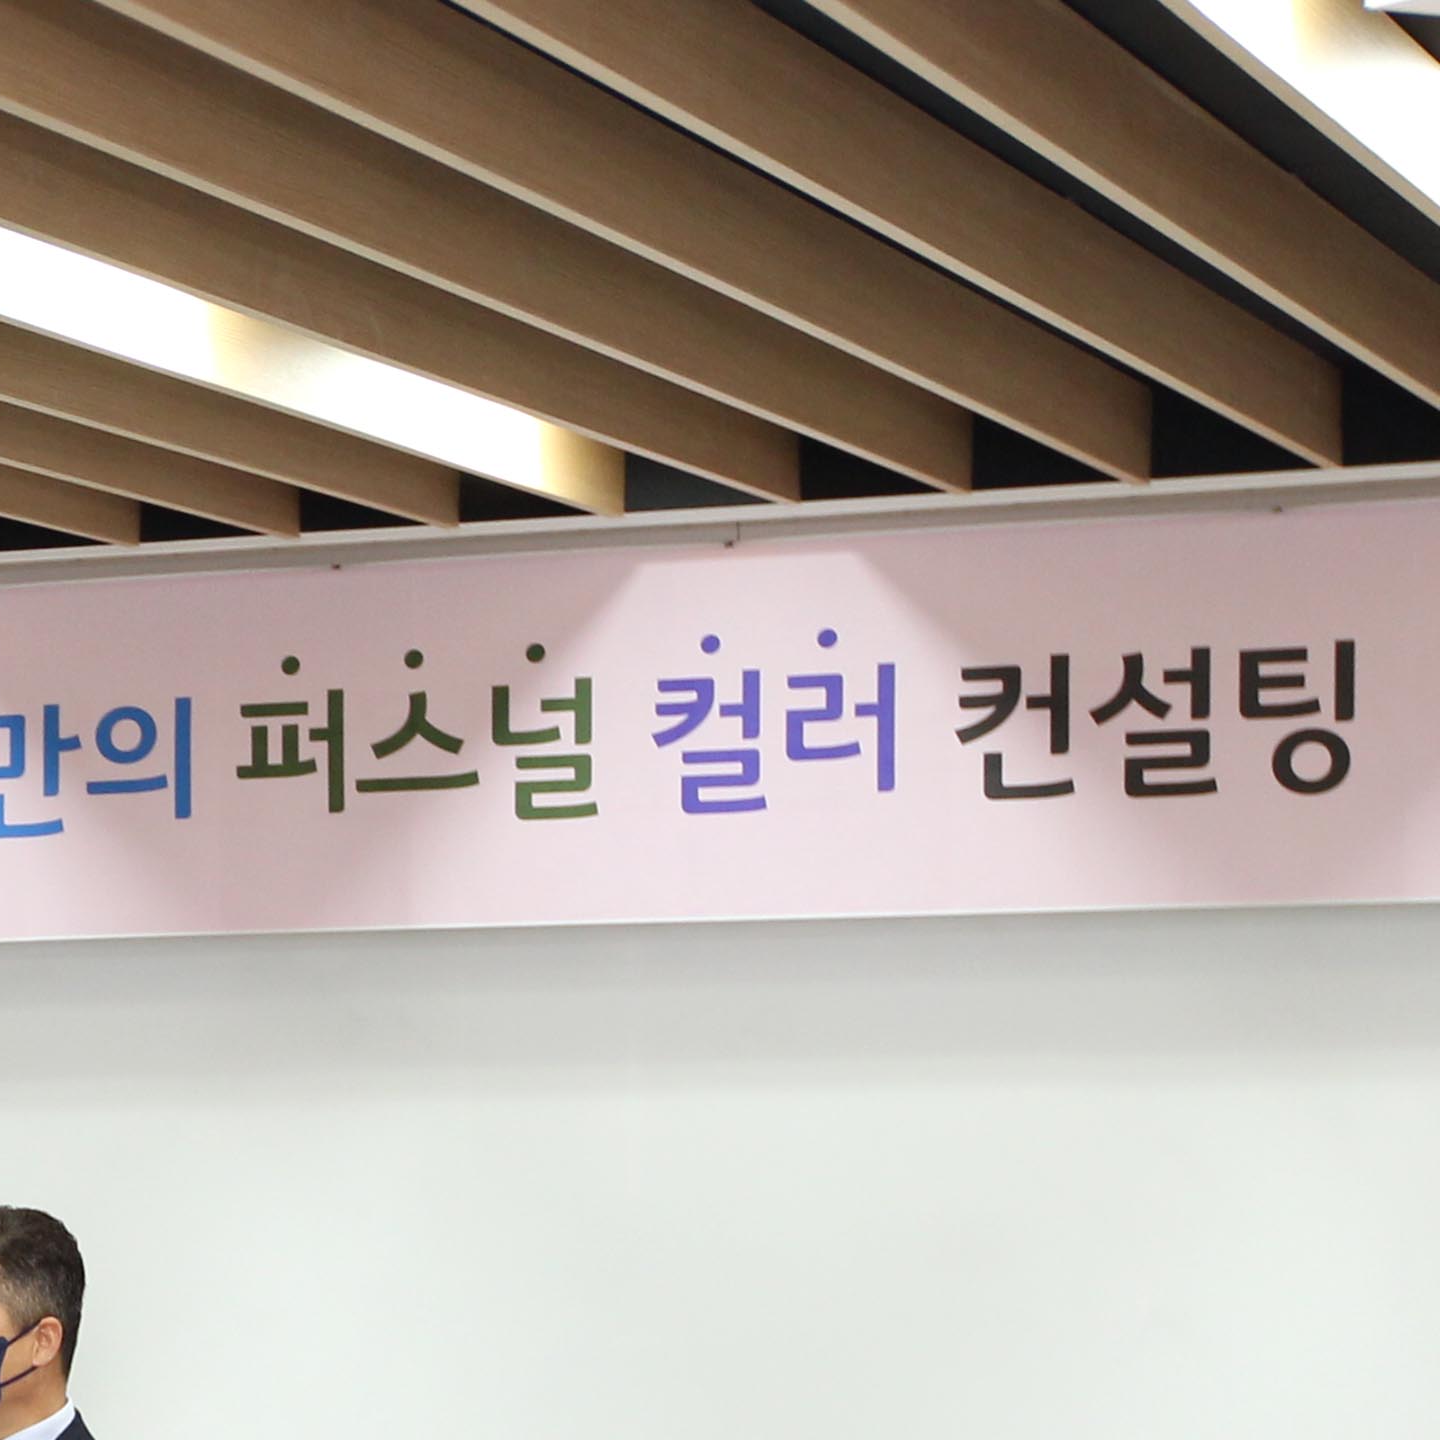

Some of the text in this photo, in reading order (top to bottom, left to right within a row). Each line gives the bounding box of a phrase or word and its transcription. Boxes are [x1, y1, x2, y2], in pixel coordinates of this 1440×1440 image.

[235, 676, 599, 820] 퍼스널
[651, 661, 896, 814] 컬러
[955, 639, 1356, 800] 컨설팅
